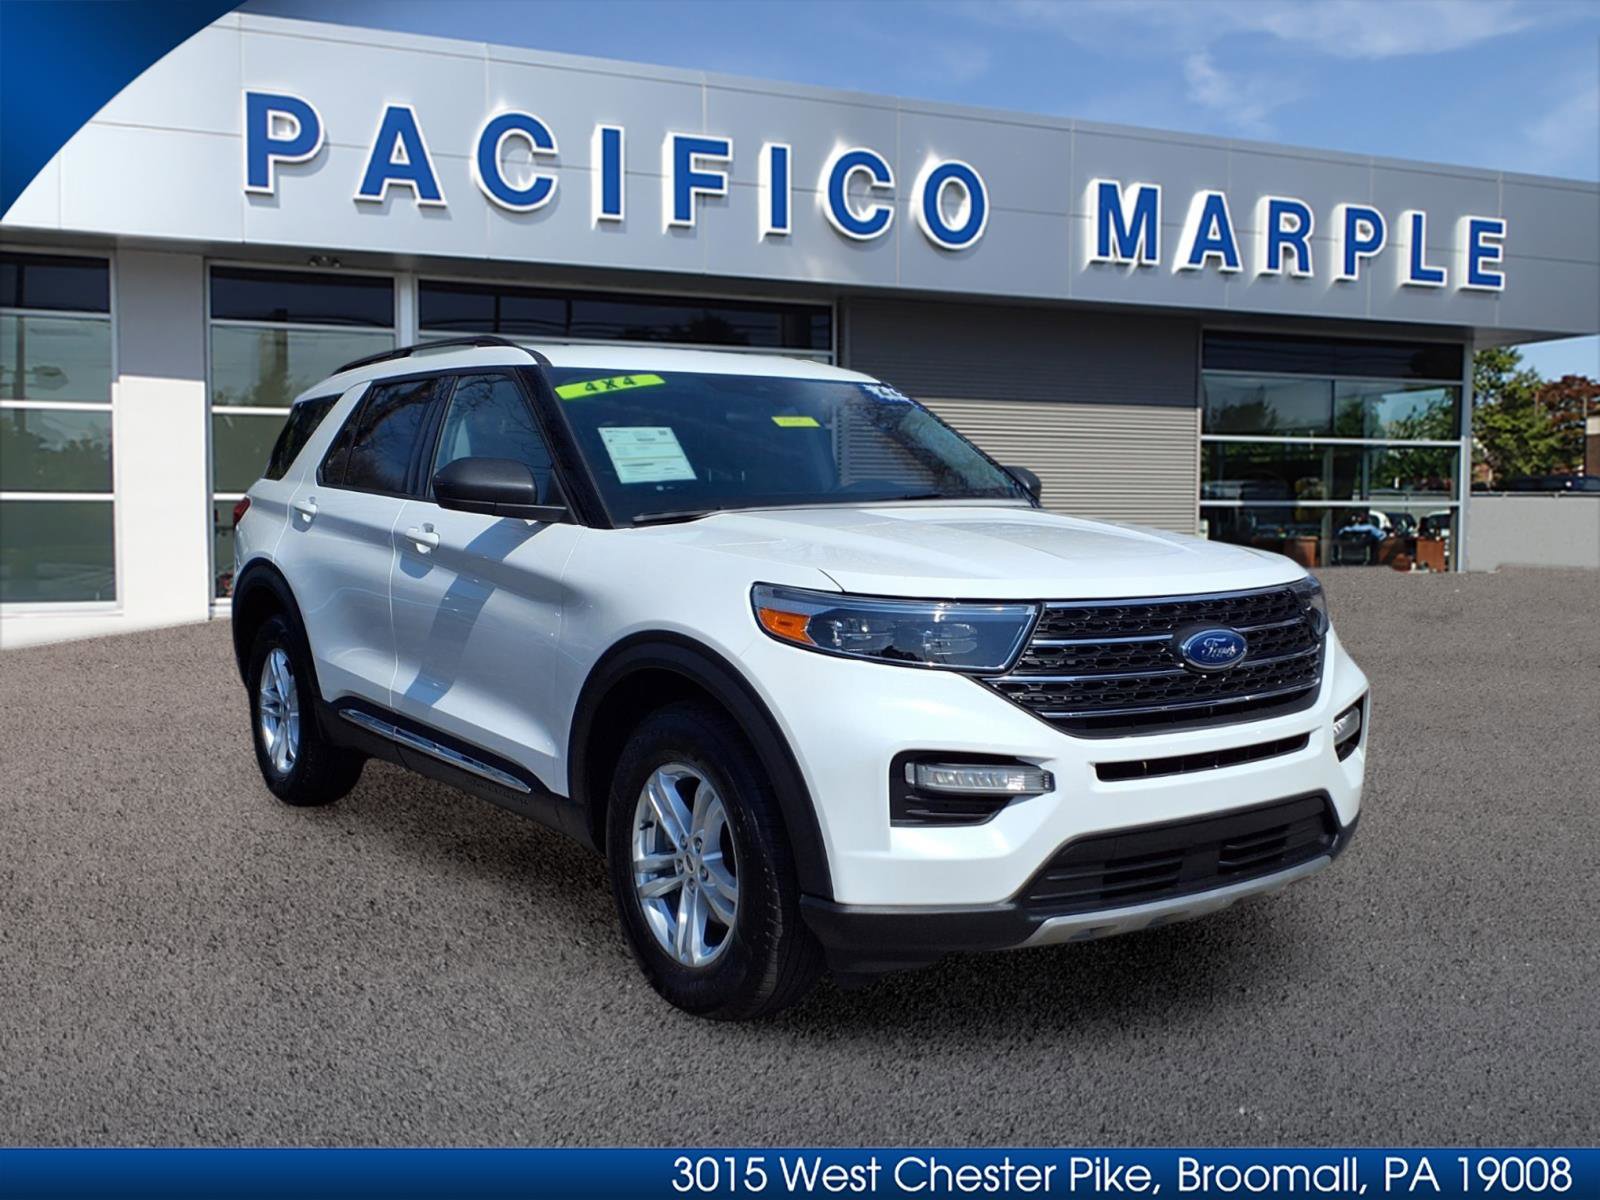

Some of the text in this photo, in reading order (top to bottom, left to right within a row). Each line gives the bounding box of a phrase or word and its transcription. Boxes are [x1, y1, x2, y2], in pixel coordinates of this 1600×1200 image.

[243, 89, 1507, 291] PACIFICO MARPLE
[1201, 637, 1236, 658] Ford
